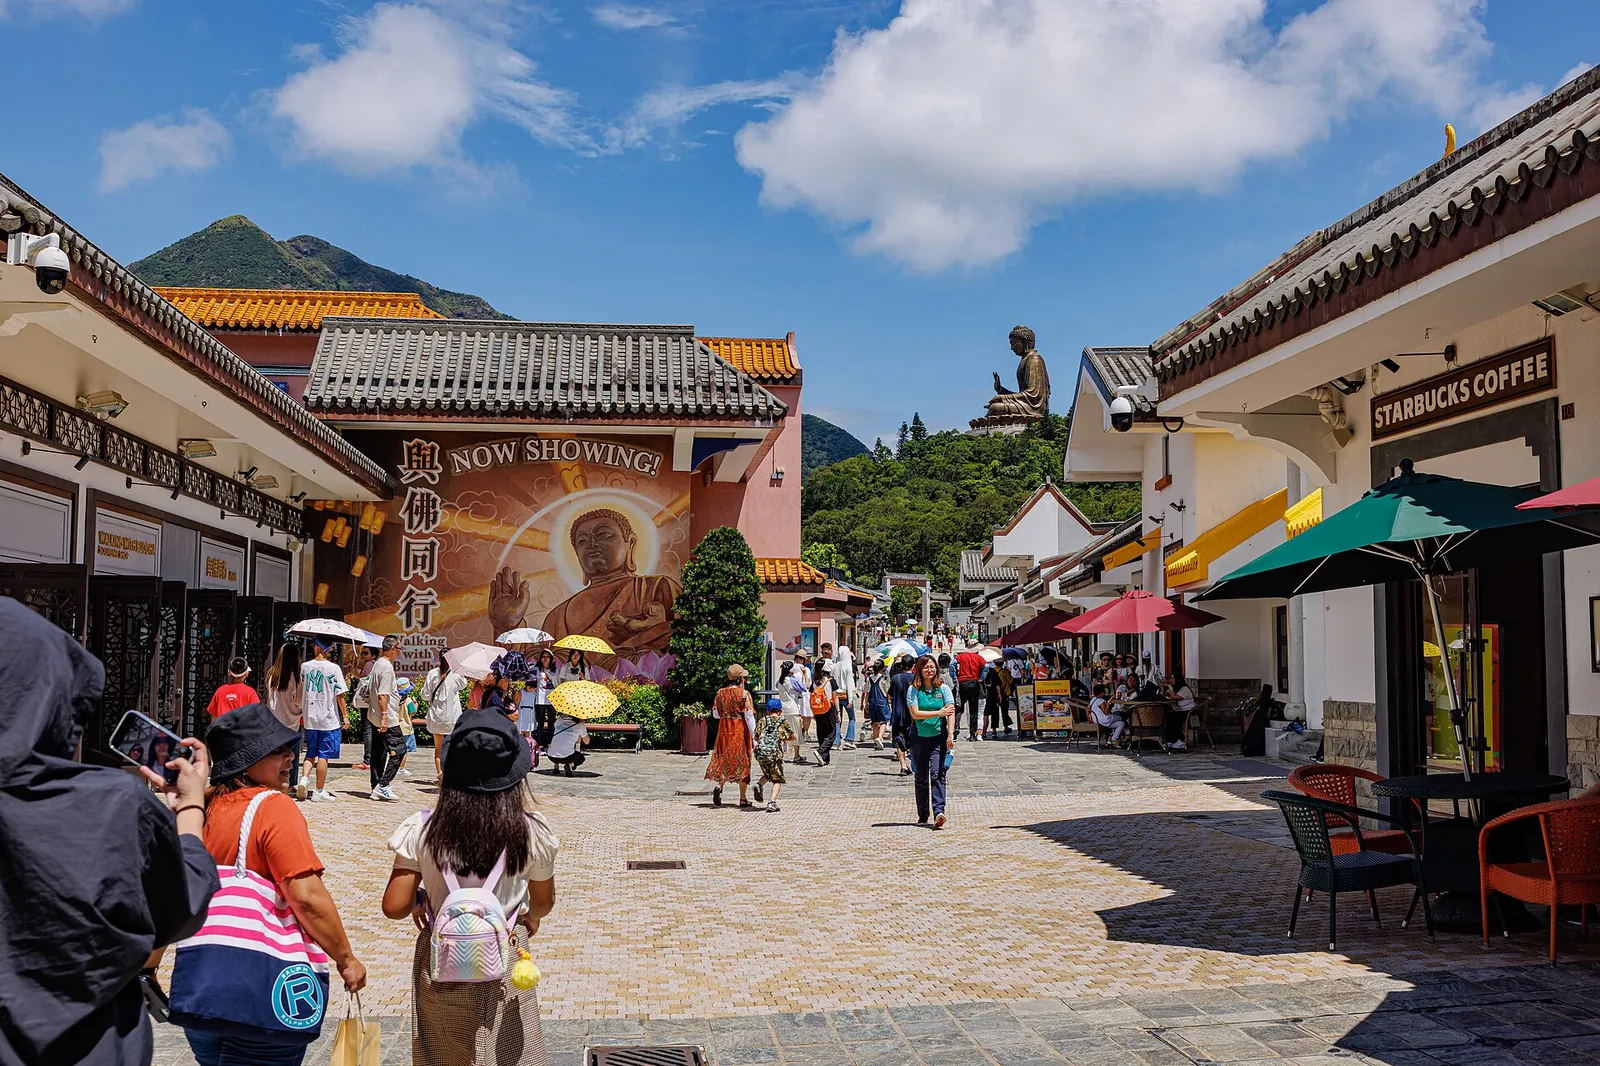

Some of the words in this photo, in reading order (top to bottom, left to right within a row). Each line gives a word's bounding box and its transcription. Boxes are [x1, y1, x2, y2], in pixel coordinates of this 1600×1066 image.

[1374, 378, 1470, 429] STARBUCKS
[1473, 351, 1548, 398] COFFEE
[450, 441, 517, 474] NOW
[525, 439, 661, 476] SHOWING!
[397, 438, 442, 632] 與佛同行
[399, 635, 445, 649] alking
[403, 648, 431, 659] with
[281, 966, 308, 979] RALPH
[284, 976, 319, 1017] R
[280, 1013, 303, 1026] RALPH
